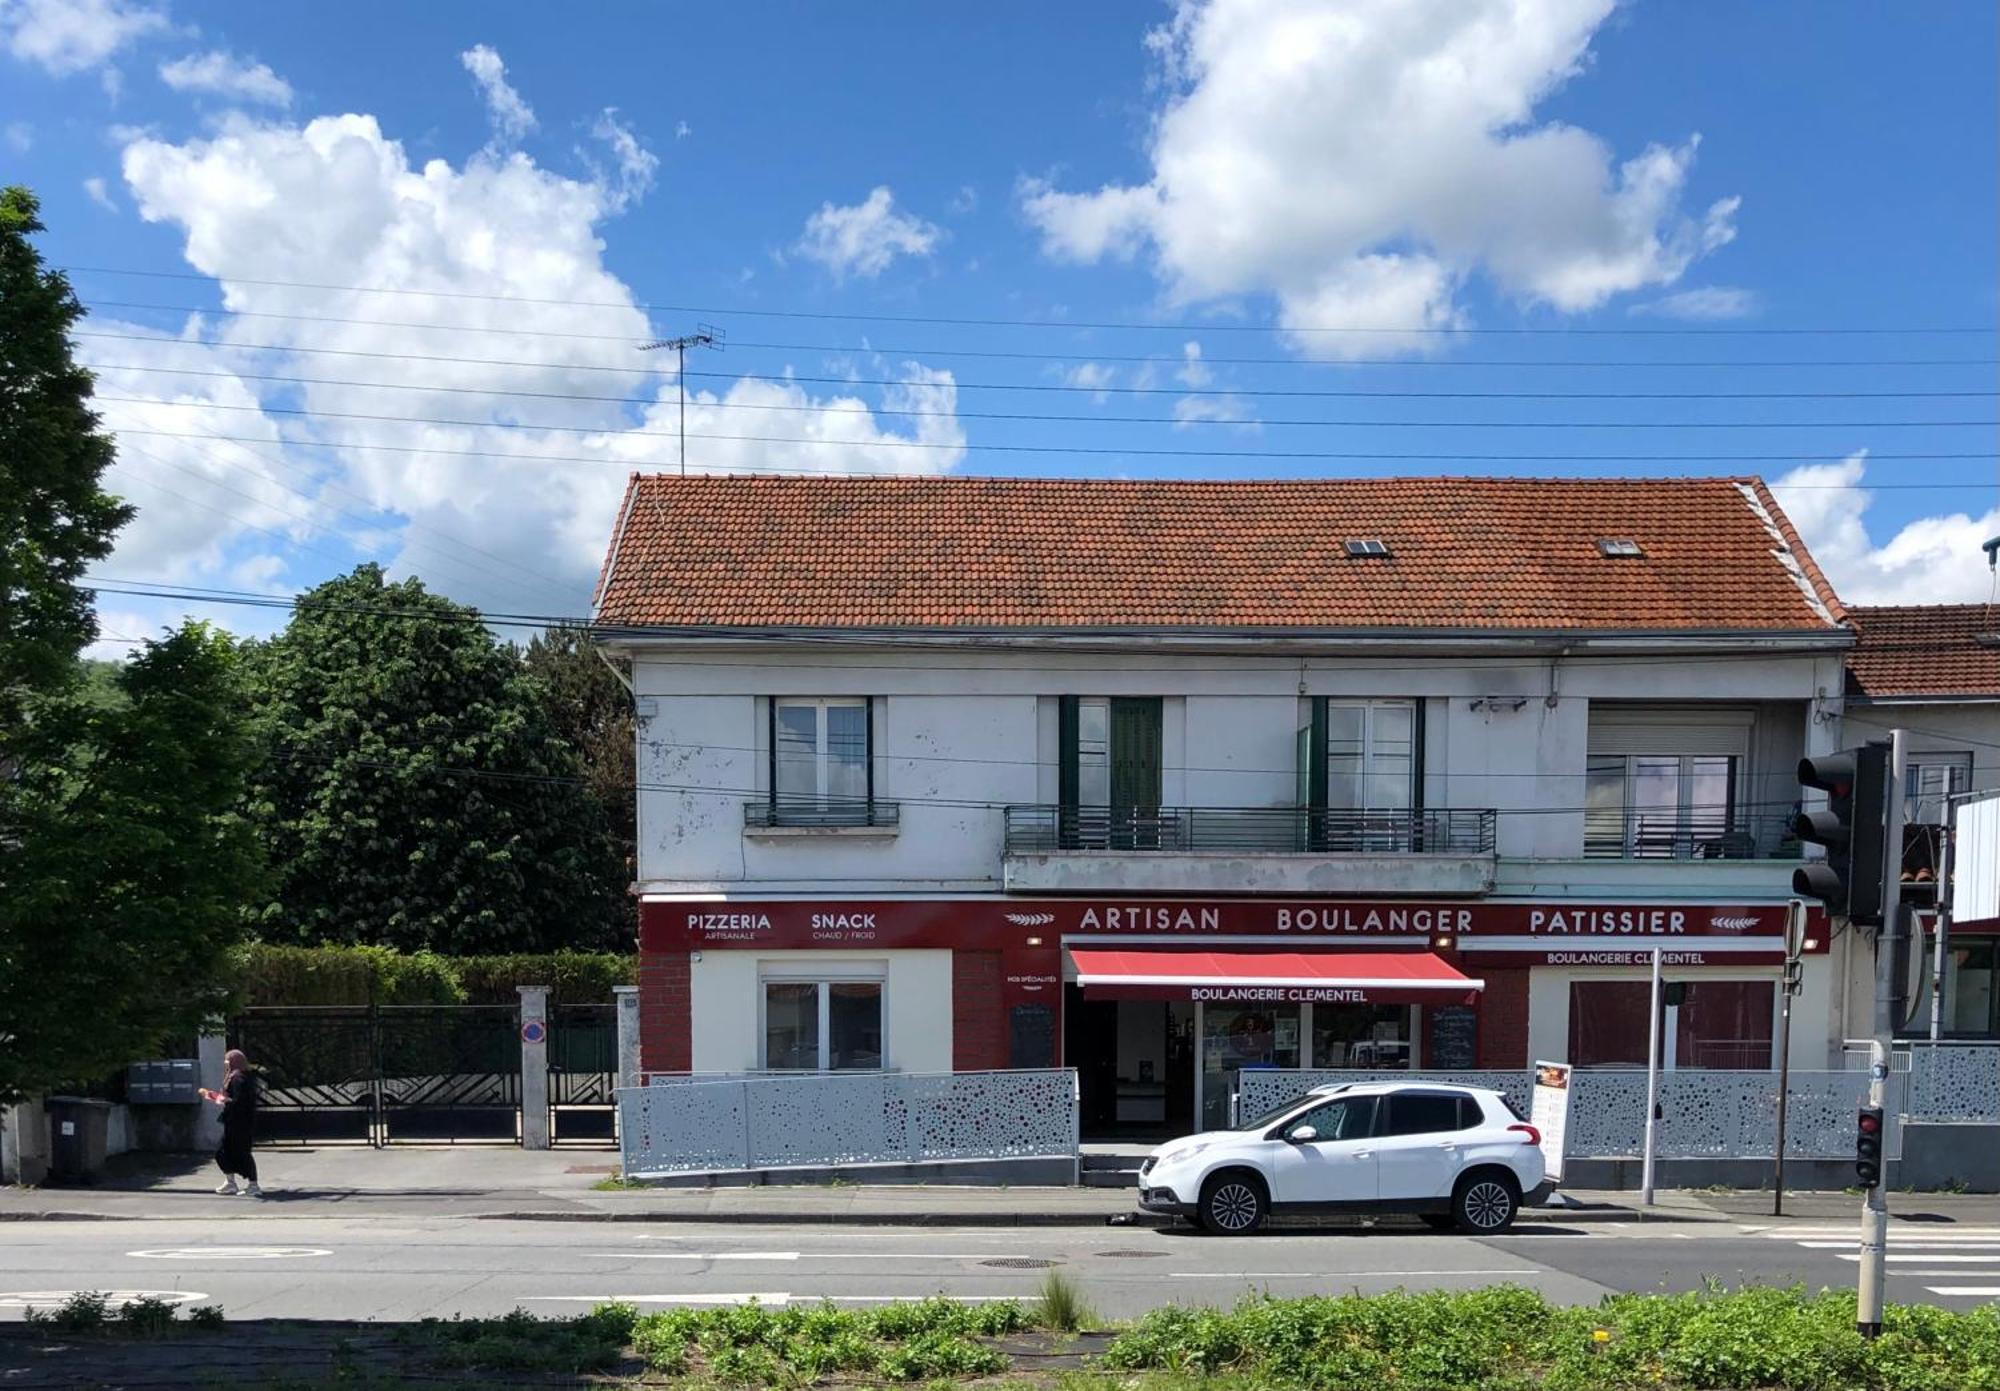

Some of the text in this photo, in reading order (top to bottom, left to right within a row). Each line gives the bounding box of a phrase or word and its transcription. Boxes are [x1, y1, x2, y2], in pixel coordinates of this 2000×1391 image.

[688, 914, 771, 929] PIZZERIA
[812, 914, 876, 929] SNACK
[1080, 907, 1685, 933] ARTISAN BOULANGER PATISSIER
[705, 932, 755, 940] ARTISANALE
[812, 931, 842, 940] CHAUD
[851, 931, 876, 940] FROID
[1547, 953, 1632, 964] BOULANGERIE
[1191, 988, 1368, 1001] BOULANGERIE CLEMENTEL
